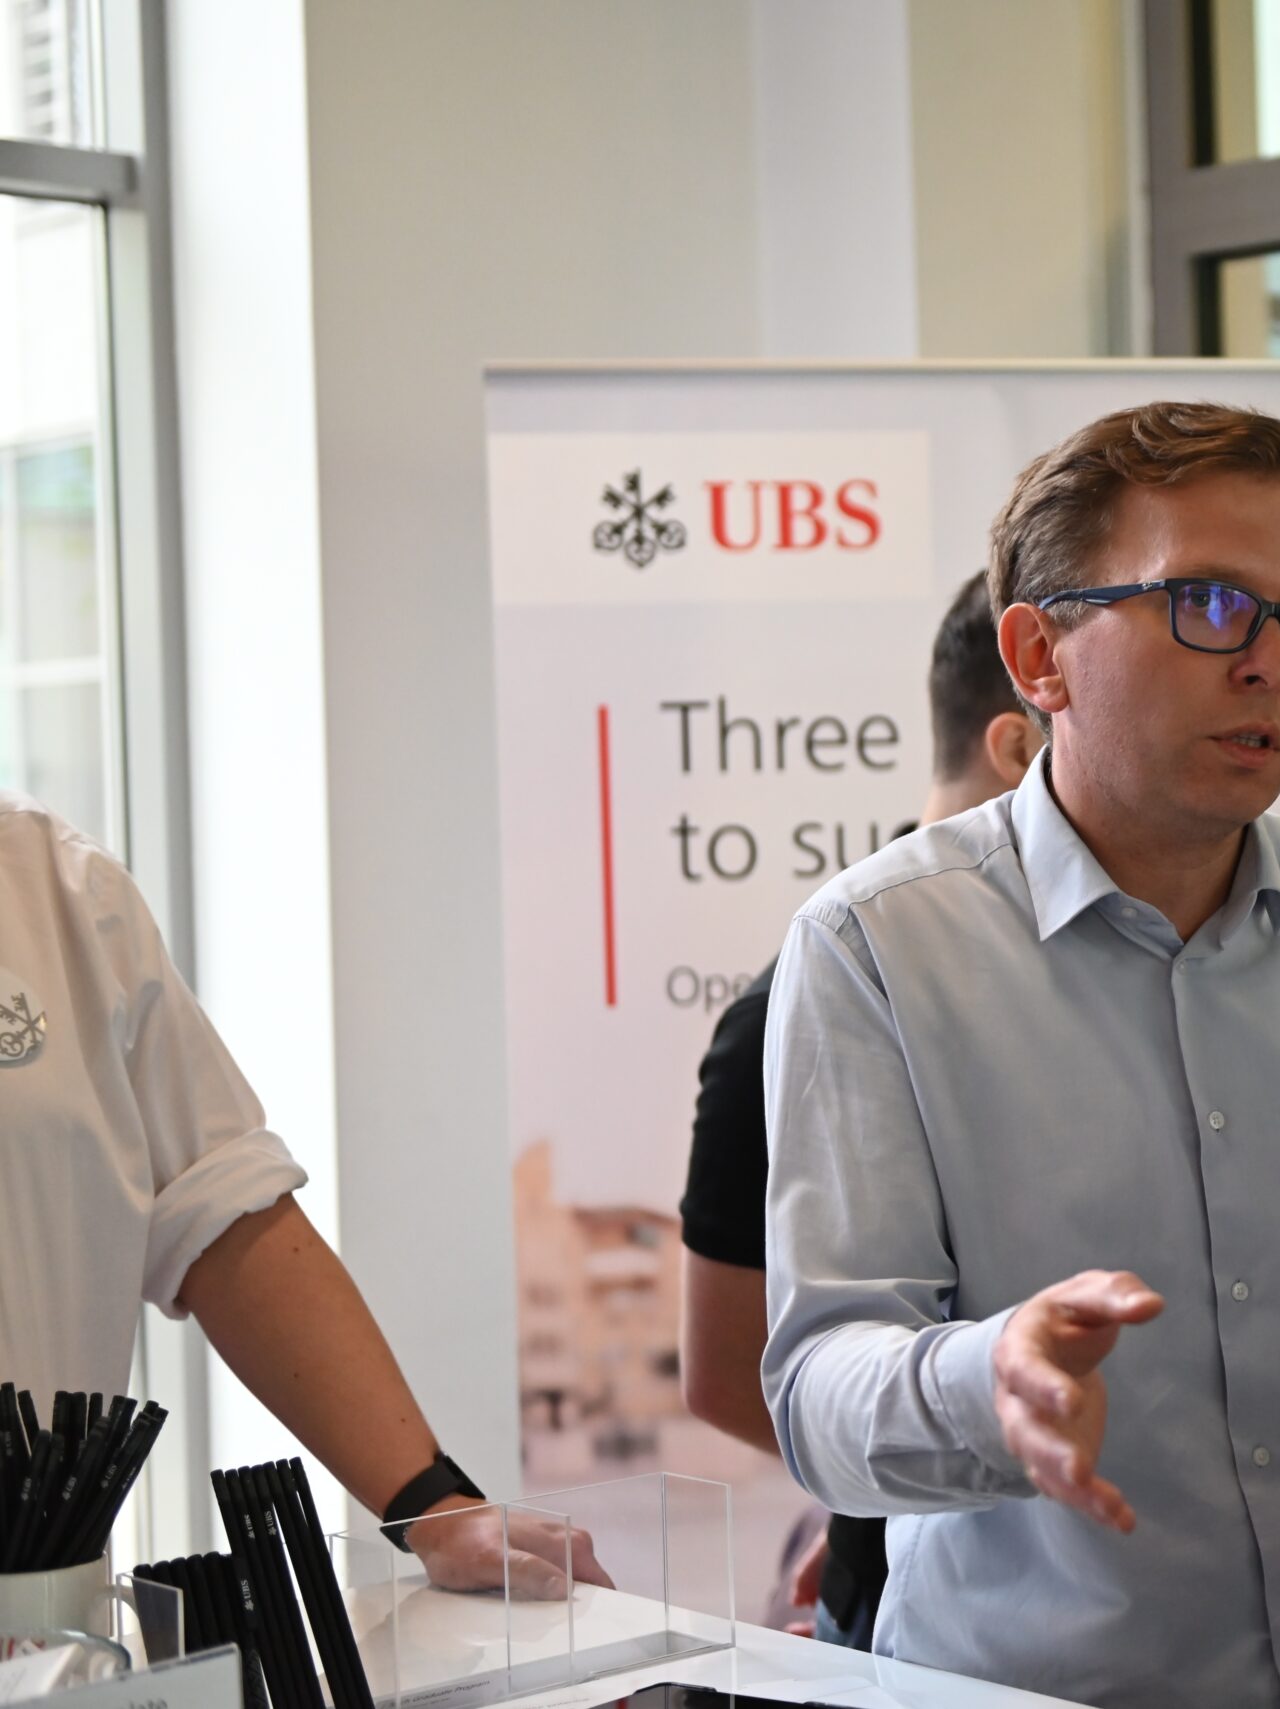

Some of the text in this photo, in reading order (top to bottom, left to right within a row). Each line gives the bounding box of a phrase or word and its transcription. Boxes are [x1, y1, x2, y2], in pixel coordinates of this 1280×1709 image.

[703, 478, 881, 553] UBS
[660, 697, 899, 773] Three
[670, 813, 757, 882] to
[241, 1579, 251, 1599] UBS
